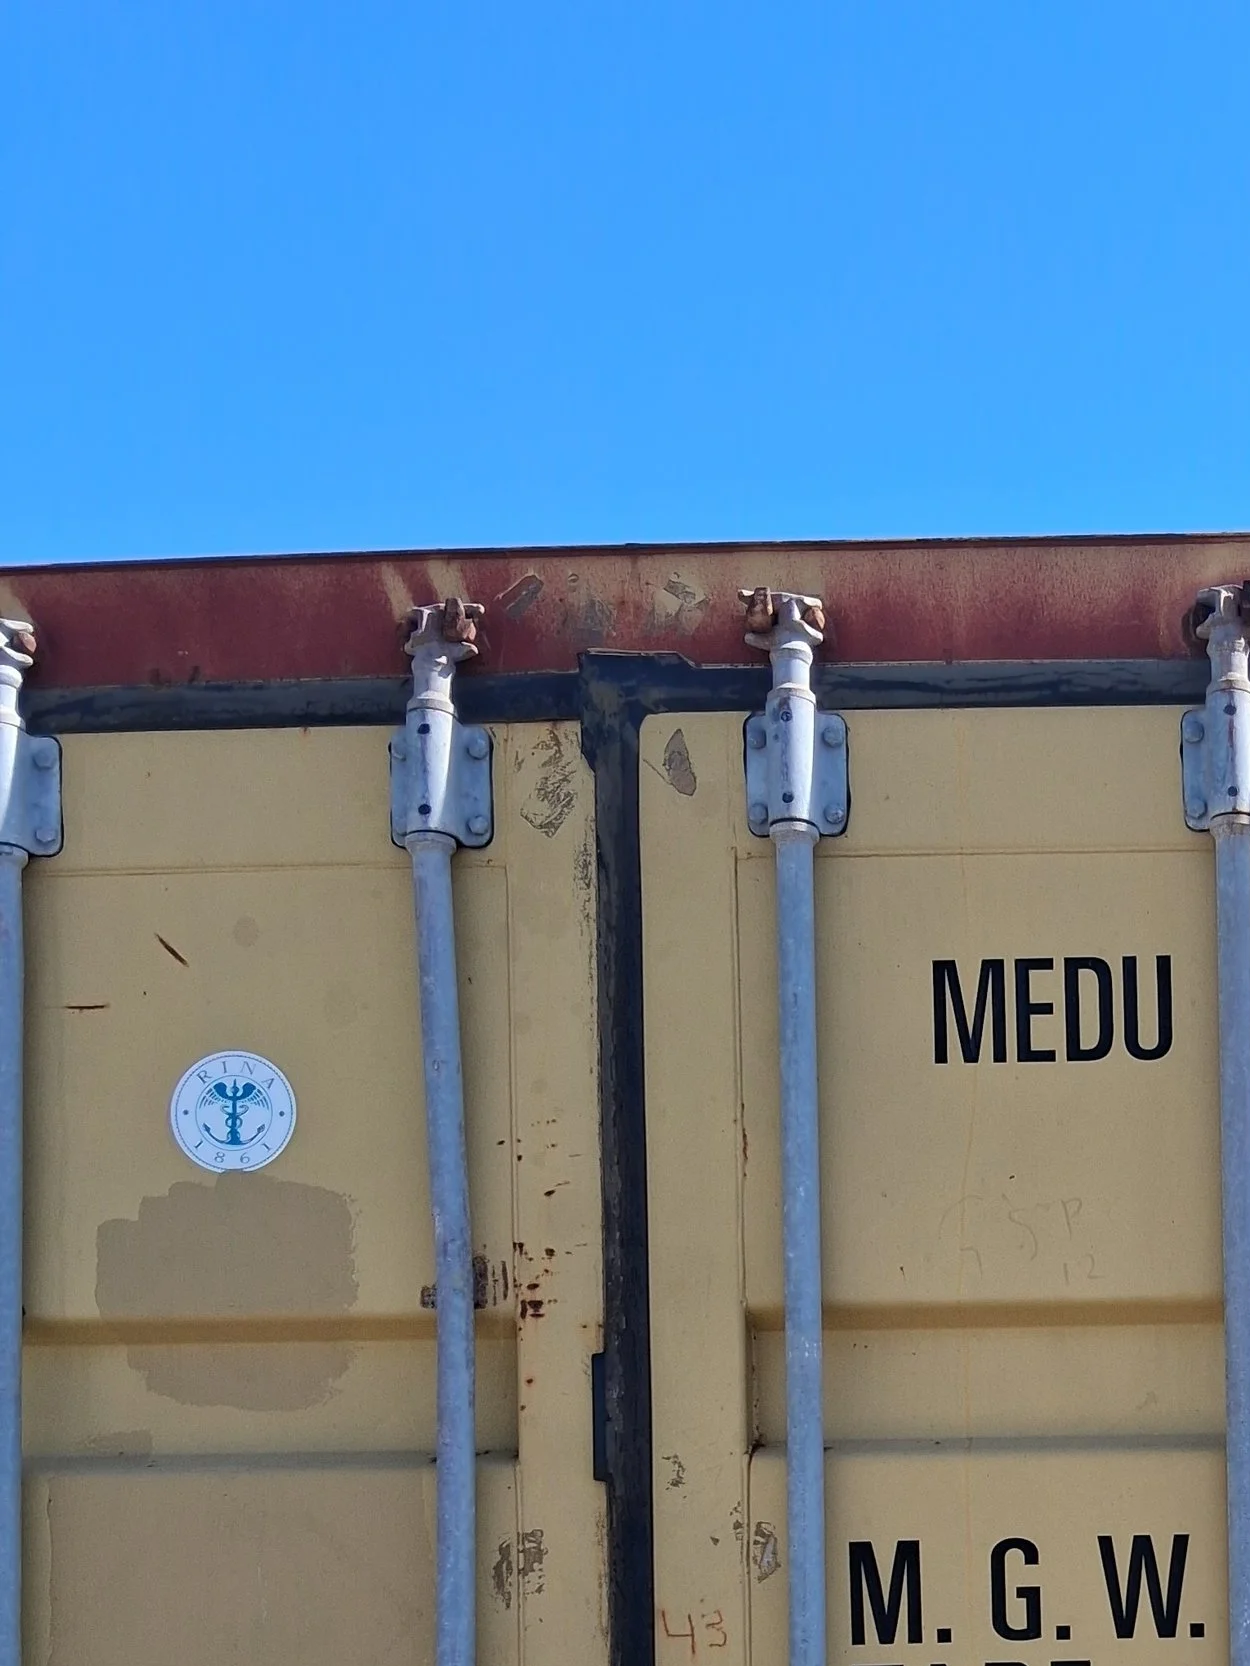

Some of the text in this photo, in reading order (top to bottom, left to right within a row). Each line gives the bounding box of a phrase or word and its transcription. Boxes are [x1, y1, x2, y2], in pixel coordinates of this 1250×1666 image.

[931, 954, 1173, 1064] MEDU
[196, 1060, 276, 1090] RINA
[194, 1139, 271, 1164] 1861
[848, 1533, 1206, 1646] M. G. W.
